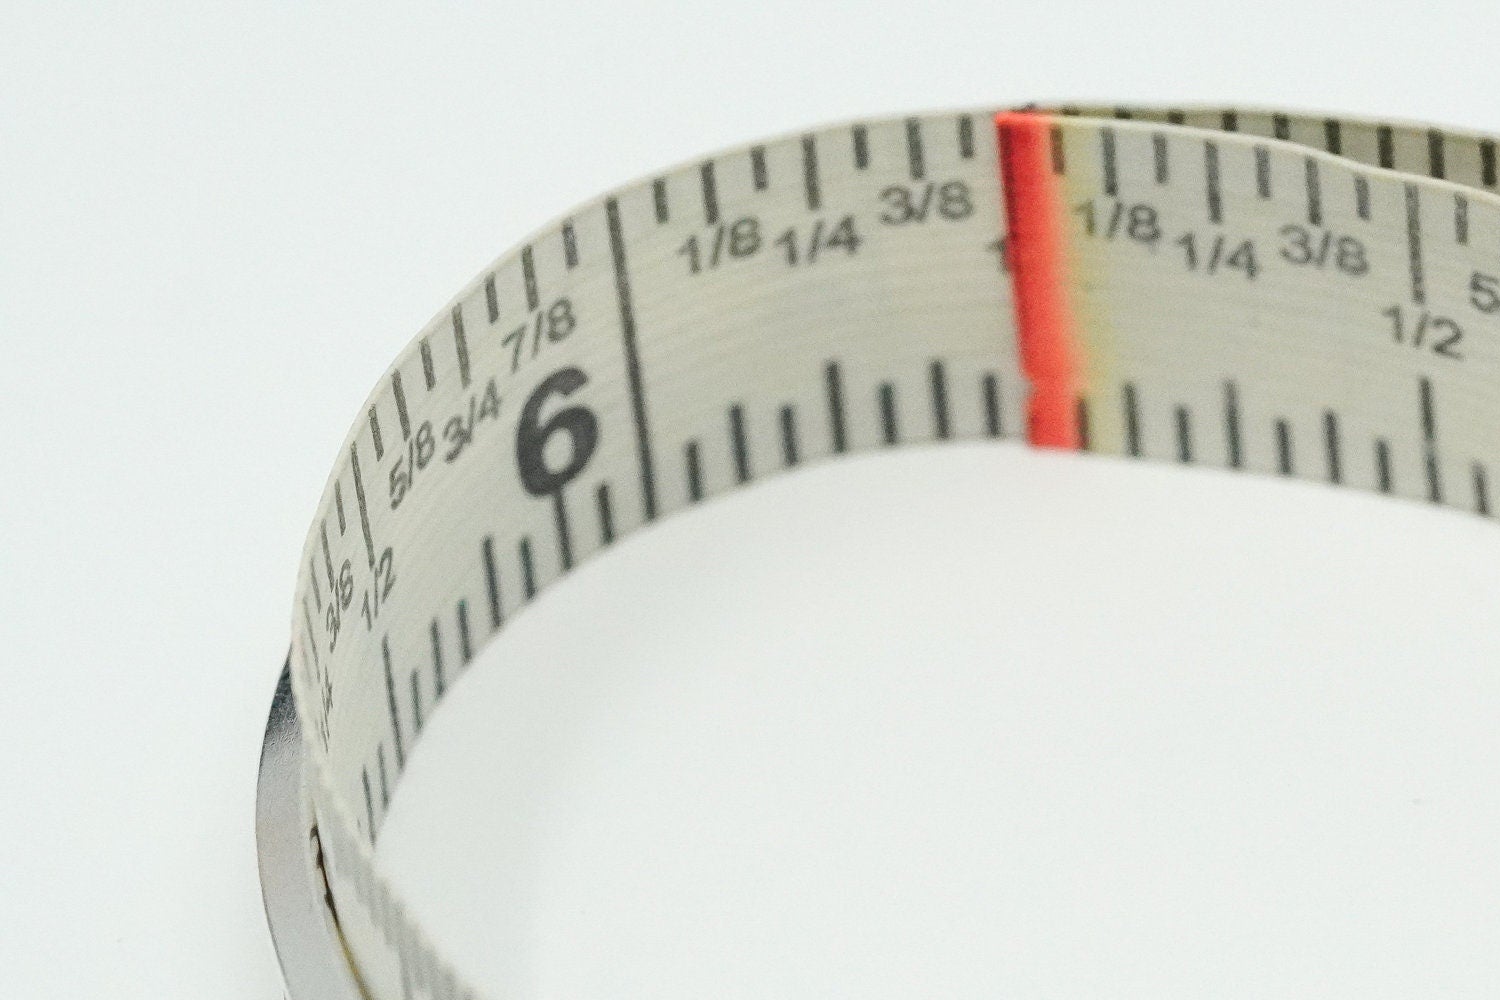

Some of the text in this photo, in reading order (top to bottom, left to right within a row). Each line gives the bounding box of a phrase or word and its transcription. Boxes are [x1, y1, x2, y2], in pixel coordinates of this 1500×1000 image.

[880, 182, 973, 227] 3/8
[1072, 199, 1160, 244] 1/8
[676, 215, 763, 275] 1/8
[774, 213, 864, 270] 1/4
[1176, 232, 1258, 279] 1/4
[1279, 226, 1369, 277] 3/8
[502, 299, 577, 375] 7/8
[1380, 304, 1466, 361] 1/2
[443, 384, 502, 465] 3/4
[515, 365, 599, 498] 6
[388, 422, 435, 511] 5/8
[361, 546, 396, 631] 1/2
